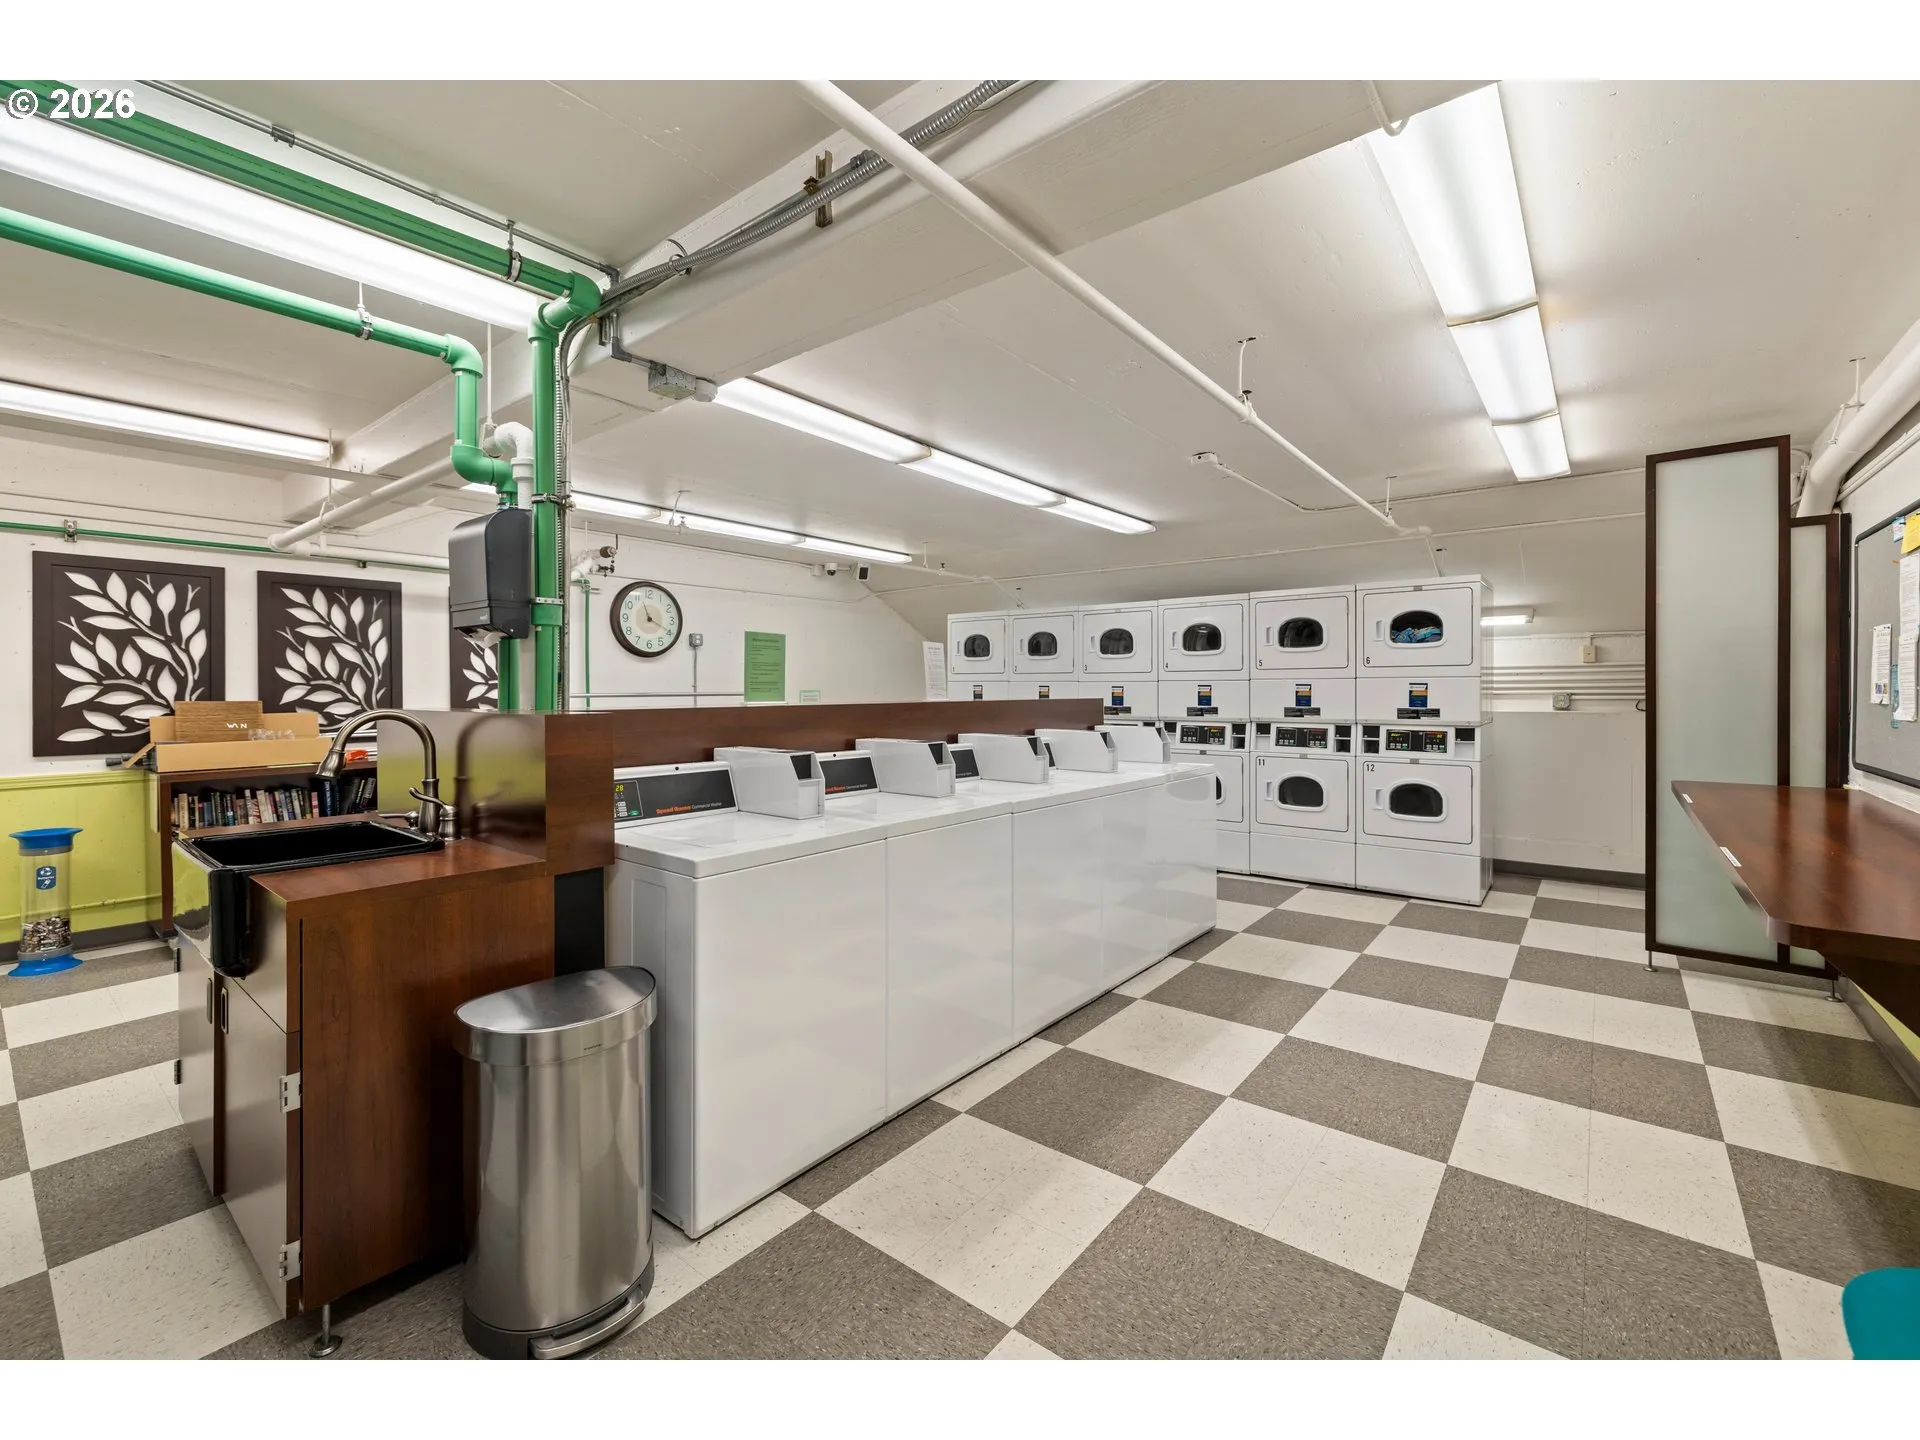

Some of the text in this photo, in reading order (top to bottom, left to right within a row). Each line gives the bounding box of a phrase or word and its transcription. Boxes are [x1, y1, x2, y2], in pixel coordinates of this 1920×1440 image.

[645, 589, 653, 599] 12
[625, 600, 633, 610] 10
[666, 604, 672, 613] 2
[622, 613, 629, 622] 9
[669, 616, 675, 625] 3
[625, 626, 632, 635] 8
[666, 629, 674, 638] 4
[635, 635, 641, 645] 7
[646, 640, 653, 649] 6
[657, 637, 664, 646] 5
[1258, 659, 1263, 667] 5
[1366, 656, 1370, 664] 6
[1258, 758, 1265, 766] 11
[1366, 763, 1375, 771] 12
[615, 784, 624, 792] 28
